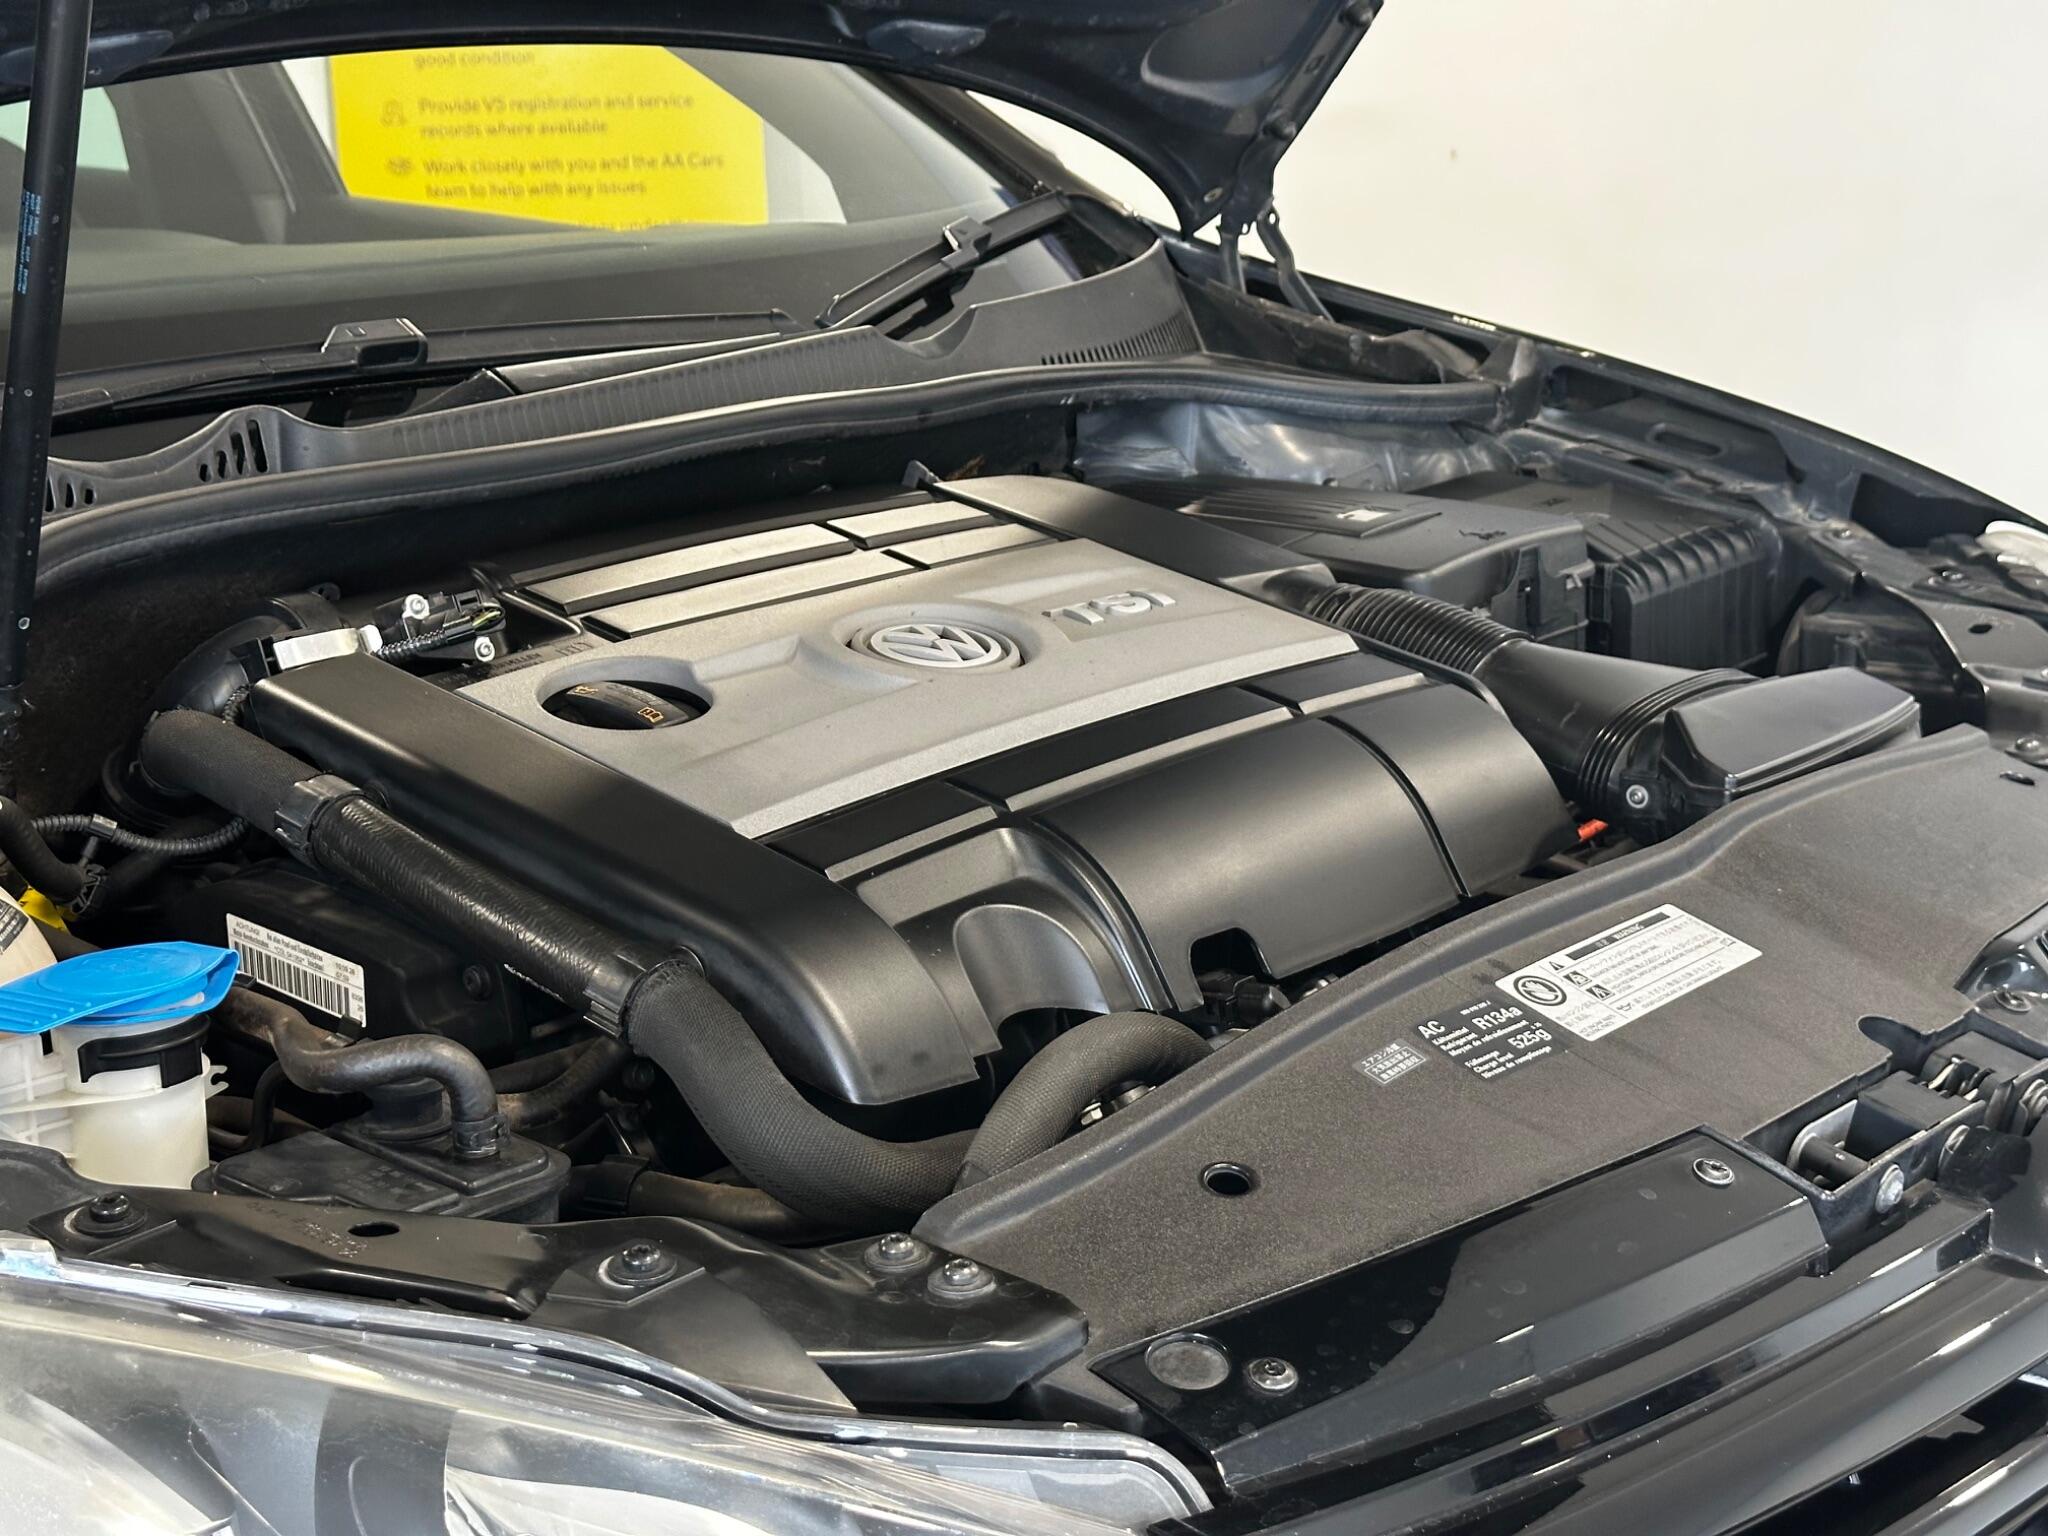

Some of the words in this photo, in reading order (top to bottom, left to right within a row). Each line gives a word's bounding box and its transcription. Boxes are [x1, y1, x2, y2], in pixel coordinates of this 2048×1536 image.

[415, 53, 456, 69] good
[460, 51, 535, 66] condition
[419, 98, 477, 113] Provide
[481, 97, 504, 111] V5
[509, 96, 599, 115] registration
[604, 96, 635, 110] and
[639, 96, 693, 109] service
[421, 122, 480, 138] records
[484, 121, 534, 135] where
[541, 119, 608, 134] available
[424, 159, 467, 174] Work
[471, 158, 524, 177] closely
[530, 157, 562, 173] with
[567, 159, 597, 175] you
[602, 155, 631, 170] and
[633, 154, 657, 169] the
[661, 152, 685, 168] AA
[687, 151, 725, 168] Cars
[426, 183, 467, 199] team
[469, 183, 487, 198] to
[489, 182, 524, 200] help
[529, 181, 561, 197] with
[566, 184, 593, 200] any
[597, 180, 647, 195] issues
[1043, 591, 1176, 626] TSI
[1472, 1006, 1523, 1030] R134a
[1418, 1020, 1446, 1039] AC
[1507, 1028, 1552, 1049] 525g
